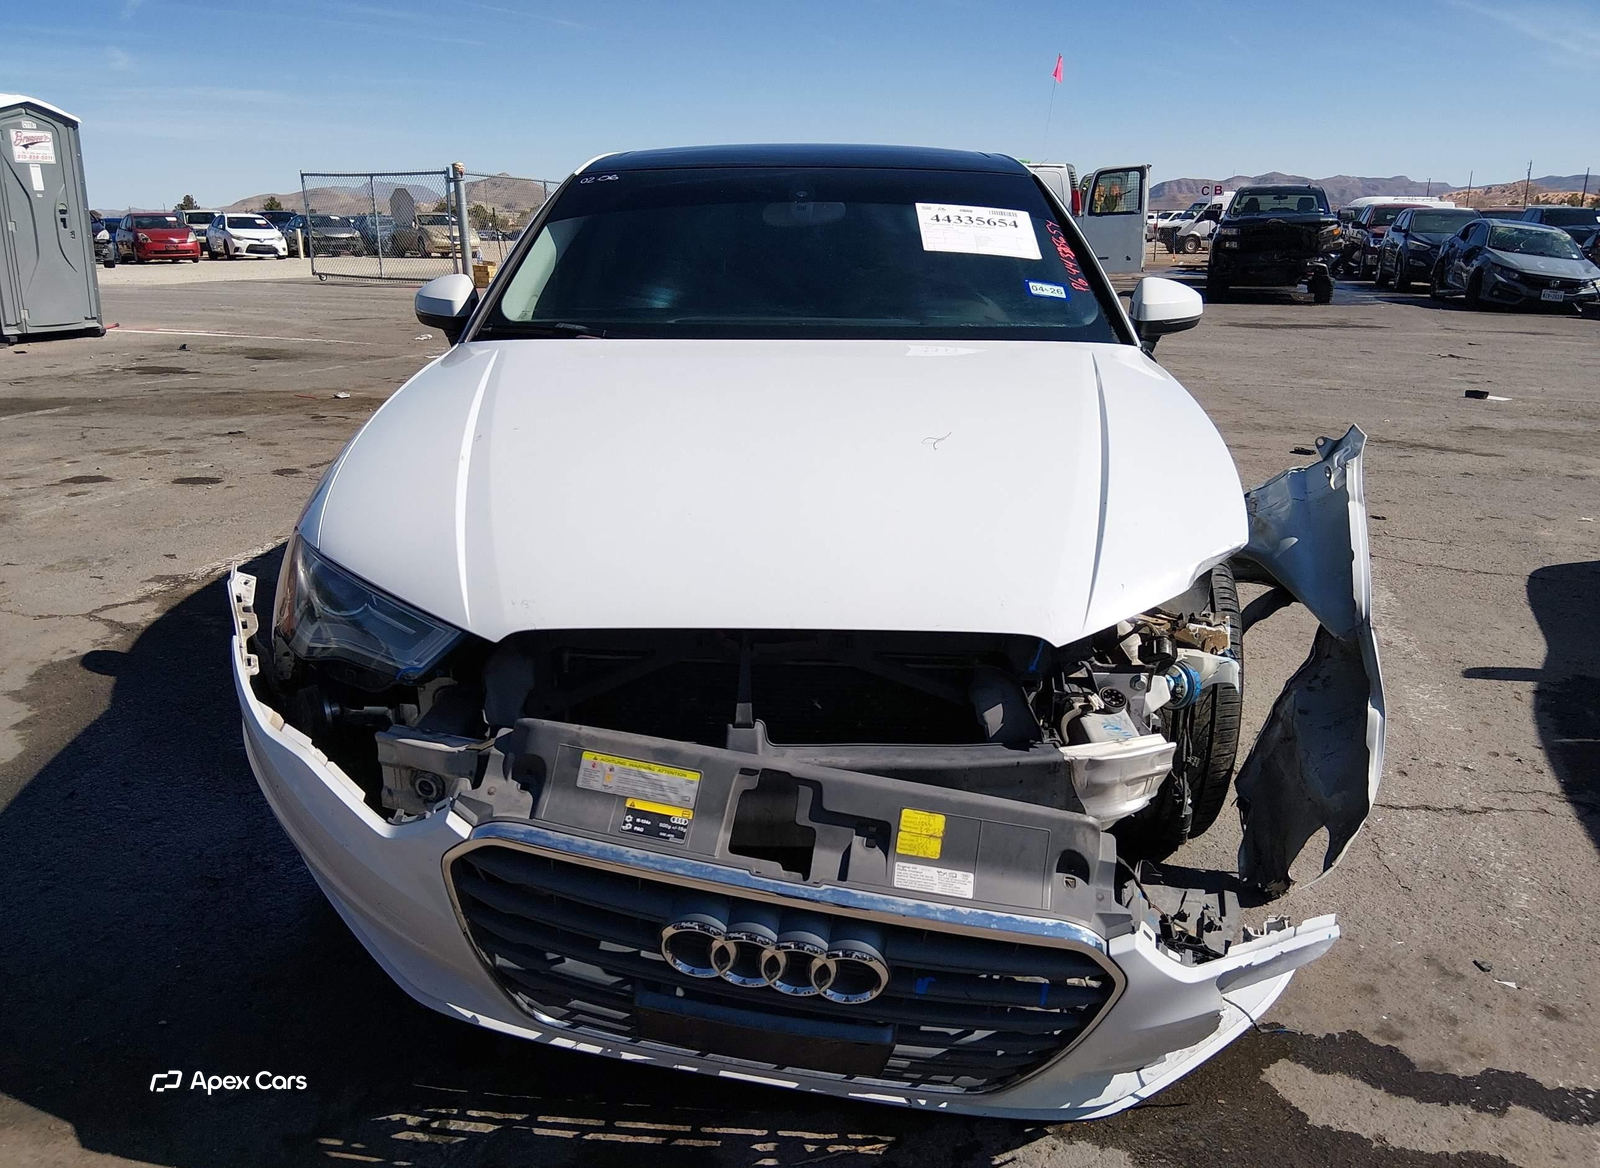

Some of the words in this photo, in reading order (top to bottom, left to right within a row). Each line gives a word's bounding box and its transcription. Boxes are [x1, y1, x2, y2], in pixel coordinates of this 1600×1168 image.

[1201, 185, 1210, 196] C
[1214, 185, 1223, 196] B
[930, 214, 1019, 229] 44335654
[629, 762, 655, 772] WARNING
[657, 767, 688, 778] ATTENTION
